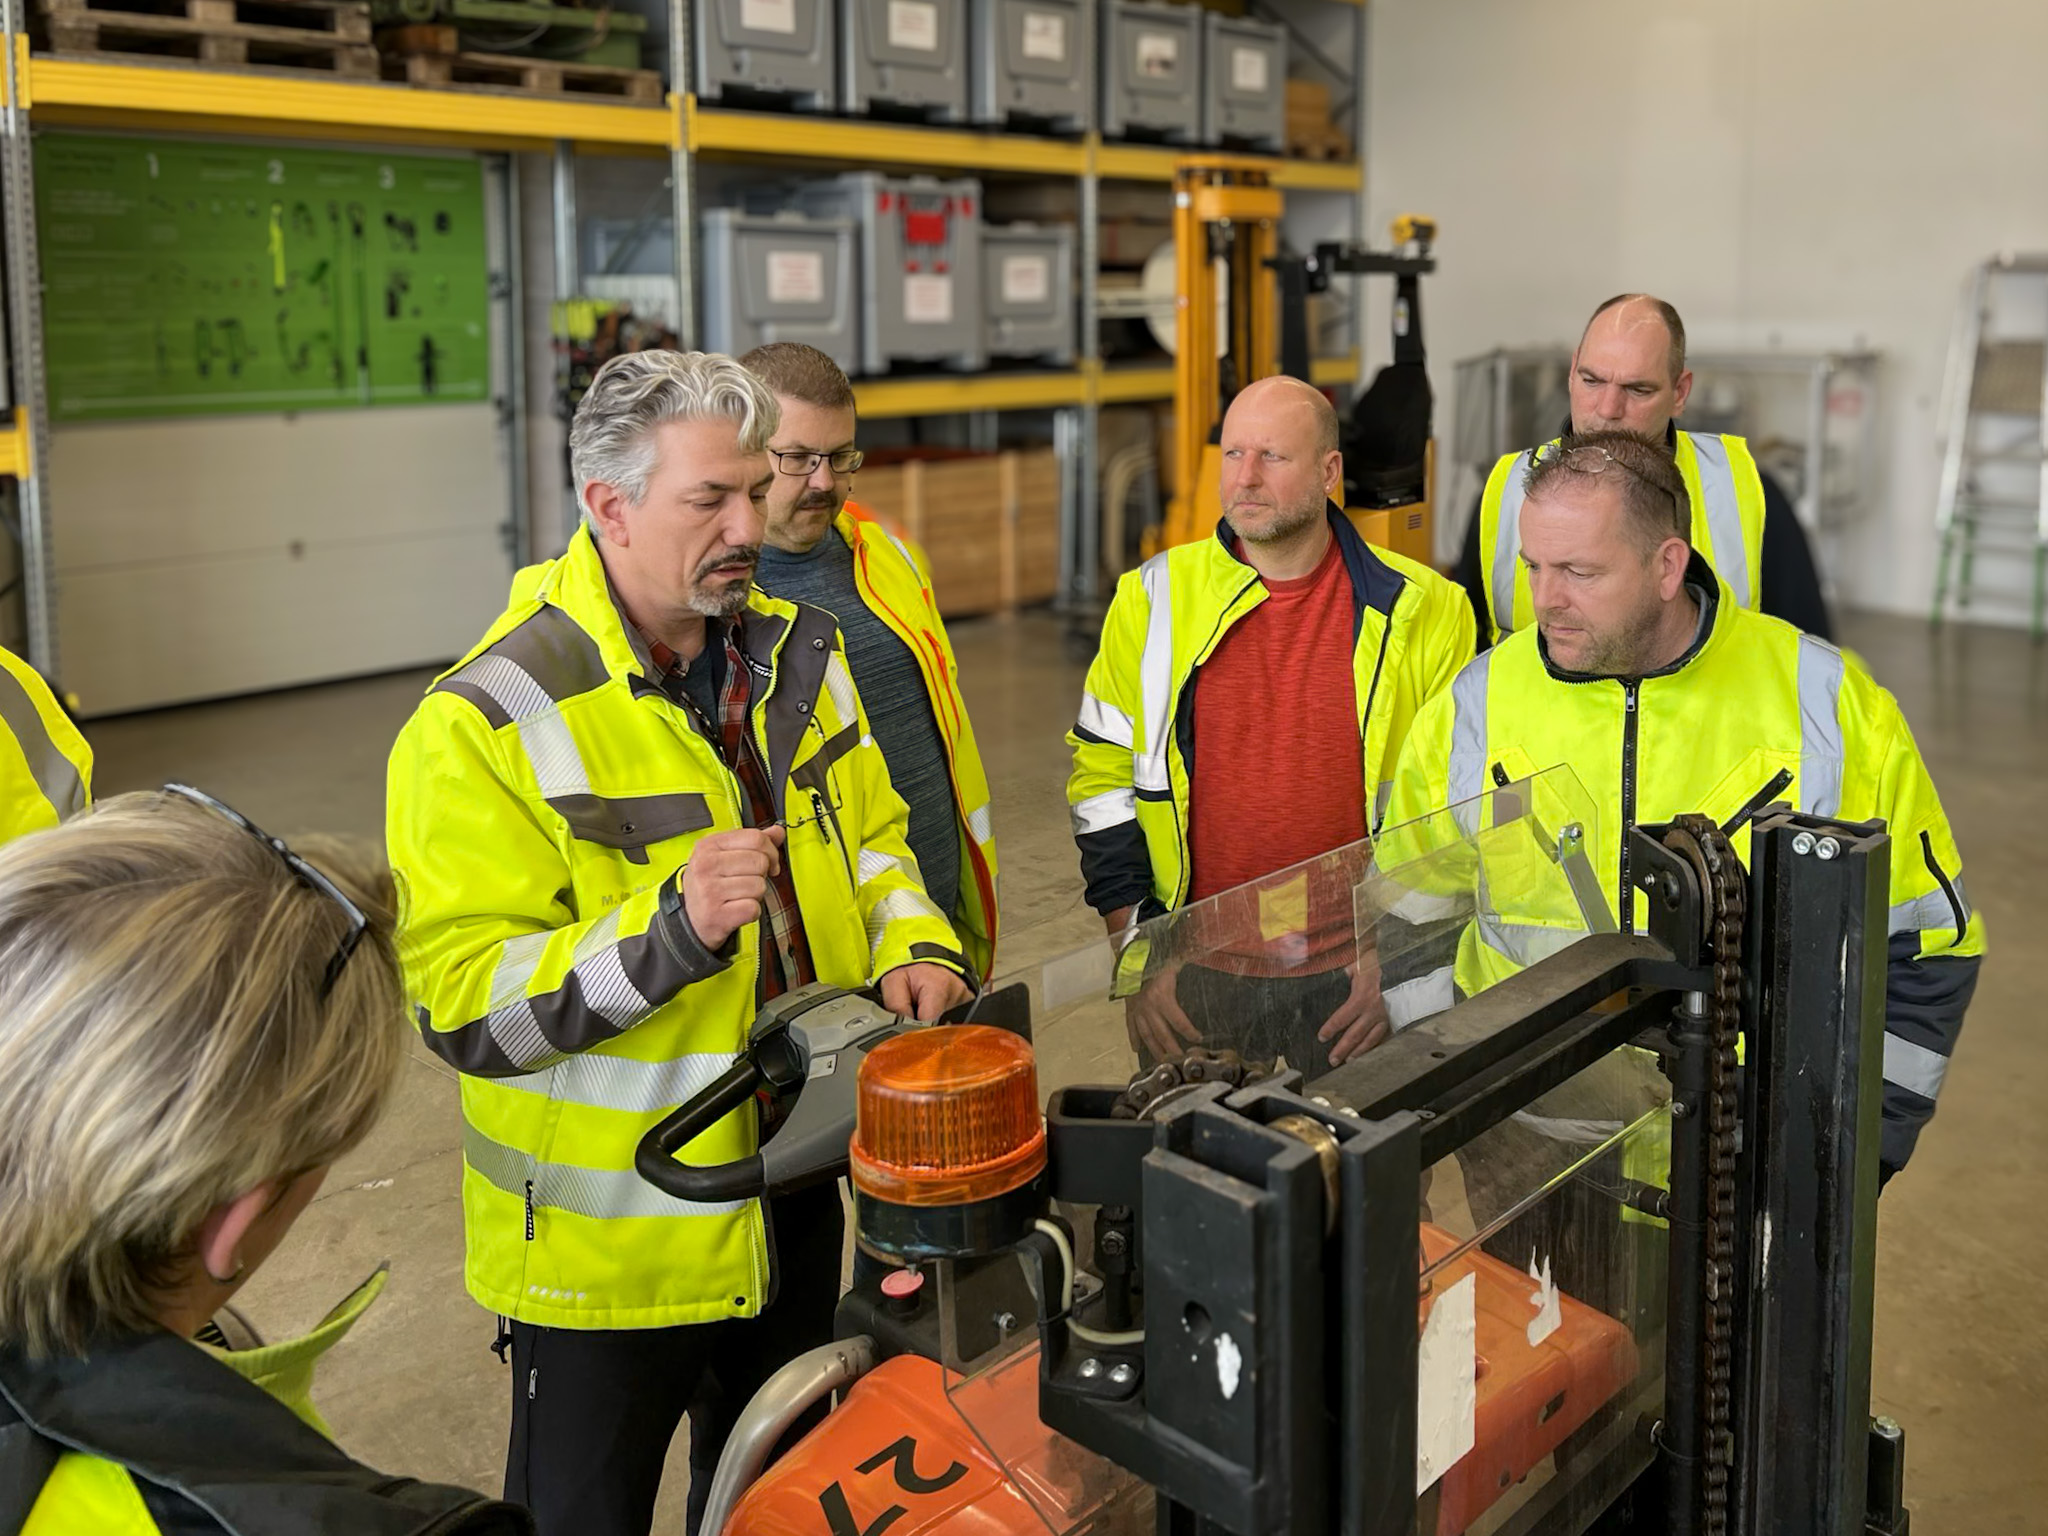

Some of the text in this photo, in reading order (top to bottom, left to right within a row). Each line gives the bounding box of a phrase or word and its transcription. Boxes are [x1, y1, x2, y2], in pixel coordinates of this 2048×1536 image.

[146, 152, 159, 179] 1
[267, 159, 285, 184] 2
[378, 164, 395, 189] 3
[818, 1435, 970, 1536] 27
